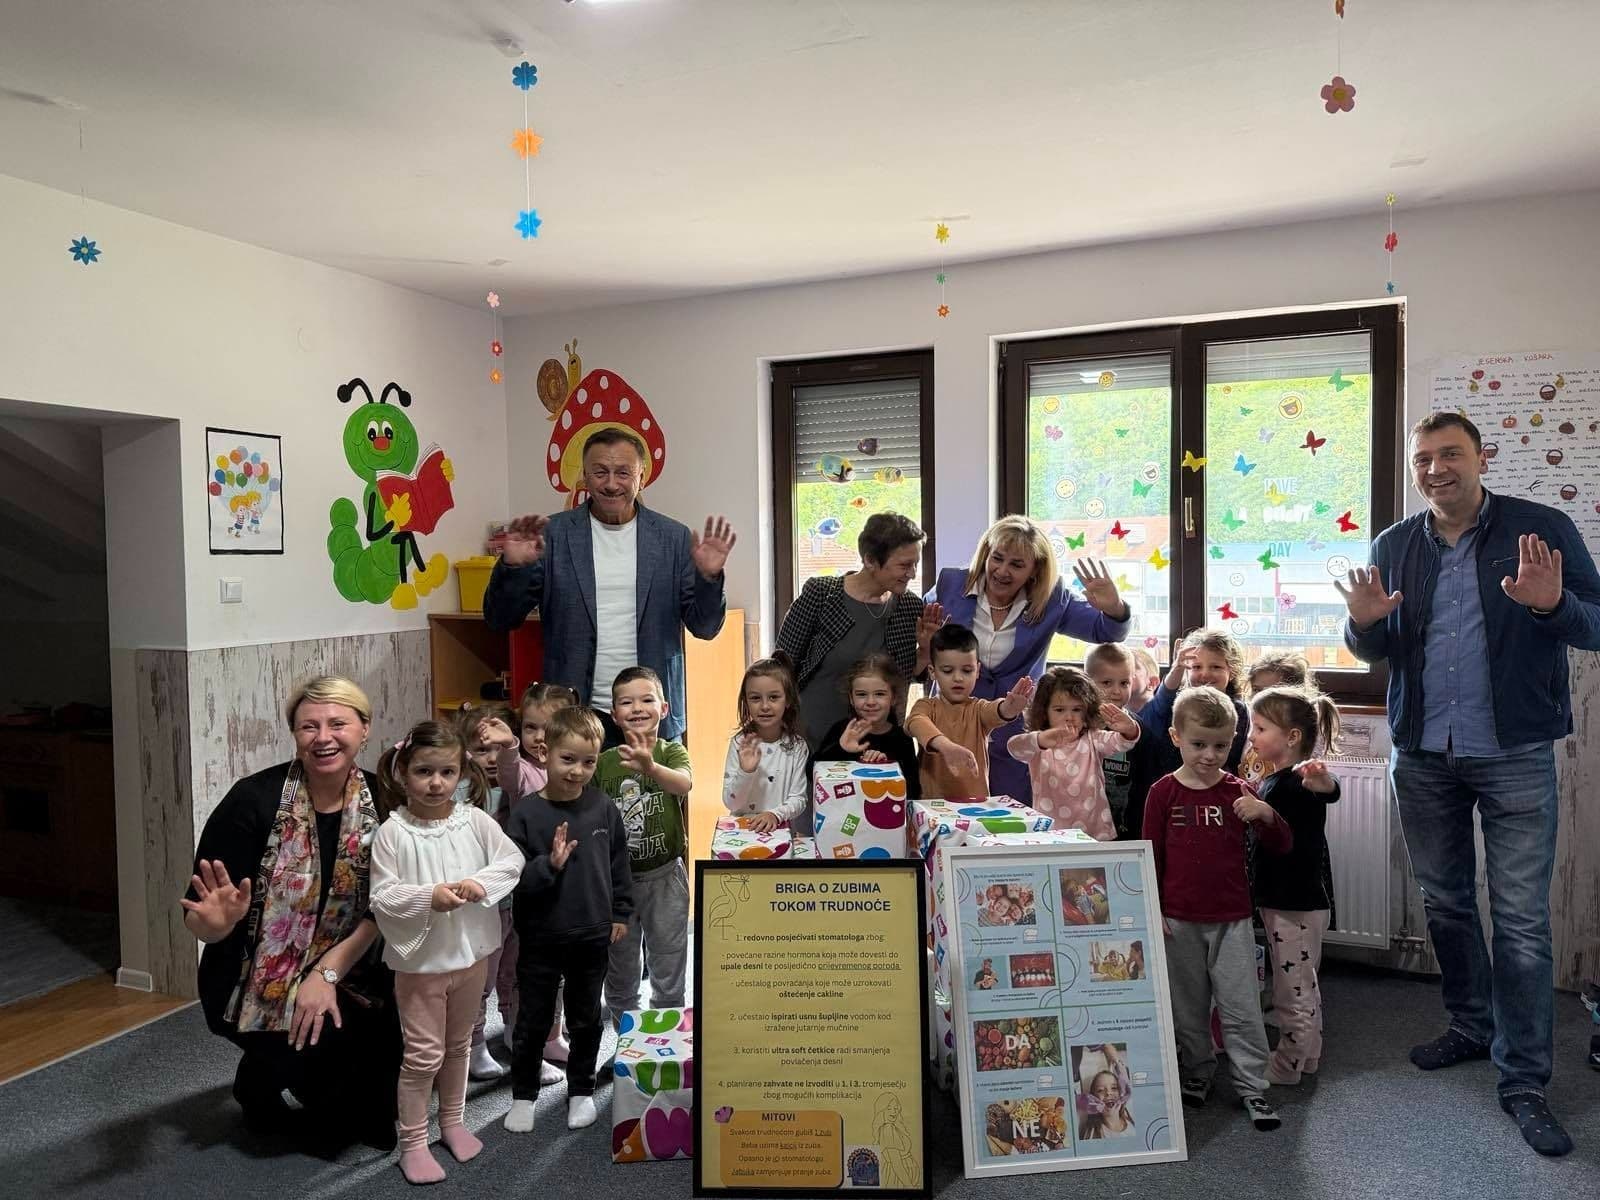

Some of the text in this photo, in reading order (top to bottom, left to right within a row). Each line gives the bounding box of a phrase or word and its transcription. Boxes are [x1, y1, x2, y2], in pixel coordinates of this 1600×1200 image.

[1269, 542, 1292, 557] DAY
[775, 883, 881, 894] BRIGA O ZUBIMA
[770, 899, 891, 911] TOKOM TRUDNOĆE
[818, 934, 864, 942] stomatologa
[822, 951, 837, 960] koja
[721, 963, 741, 971] upale
[815, 979, 830, 987] koje
[832, 979, 851, 987] može
[853, 979, 891, 987] uzrokovati
[771, 1013, 797, 1022] ispirati
[819, 1013, 848, 1022] šupljine
[765, 1024, 795, 1032] izražene
[796, 1024, 825, 1033] jutarnje
[1005, 1034, 1032, 1050] DA
[727, 1080, 762, 1089] planirane
[764, 1080, 793, 1088] zahvate
[763, 1092, 781, 1101] zbog
[761, 1113, 796, 1121] MITOVI
[1012, 1119, 1041, 1139] NE
